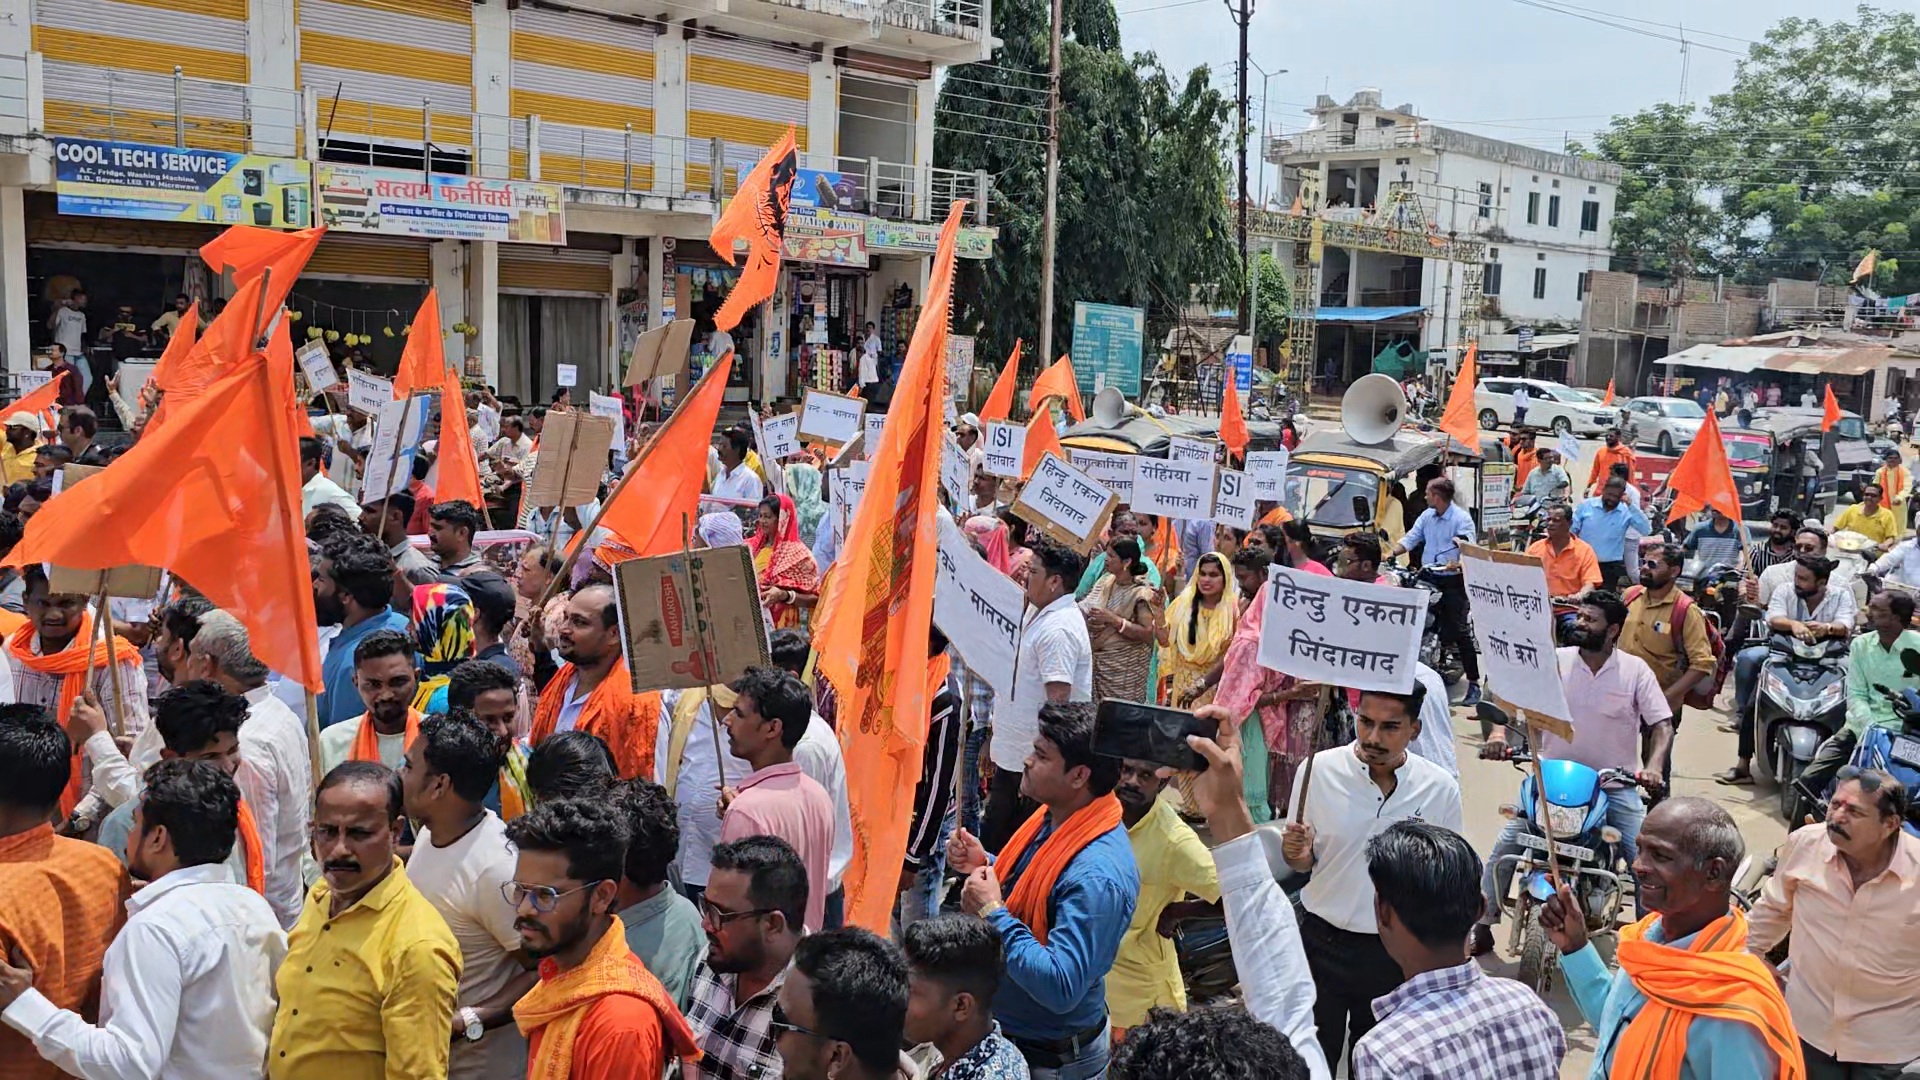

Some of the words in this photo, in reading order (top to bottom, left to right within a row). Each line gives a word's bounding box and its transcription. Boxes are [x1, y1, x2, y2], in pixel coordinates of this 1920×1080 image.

[57, 143, 108, 165] COOL
[111, 148, 157, 169] TECH
[161, 152, 227, 175] SERVICE
[127, 171, 160, 181] Washing
[158, 181, 200, 191] Microwave
[374, 179, 433, 201] सत्यम
[440, 181, 512, 208] फर्नीचर्स
[833, 220, 861, 233] FARM
[992, 426, 1012, 448] ISI
[1140, 461, 1191, 484] रोहिंग्या
[1039, 487, 1087, 525] जिंदाबाद
[1072, 478, 1107, 507] एकता
[663, 582, 680, 640] MAHAKOSH
[970, 588, 1018, 650] मातरम्
[1341, 595, 1423, 627] एकता
[1288, 628, 1399, 675] जिंदाबाद
[1513, 638, 1540, 670] करो
